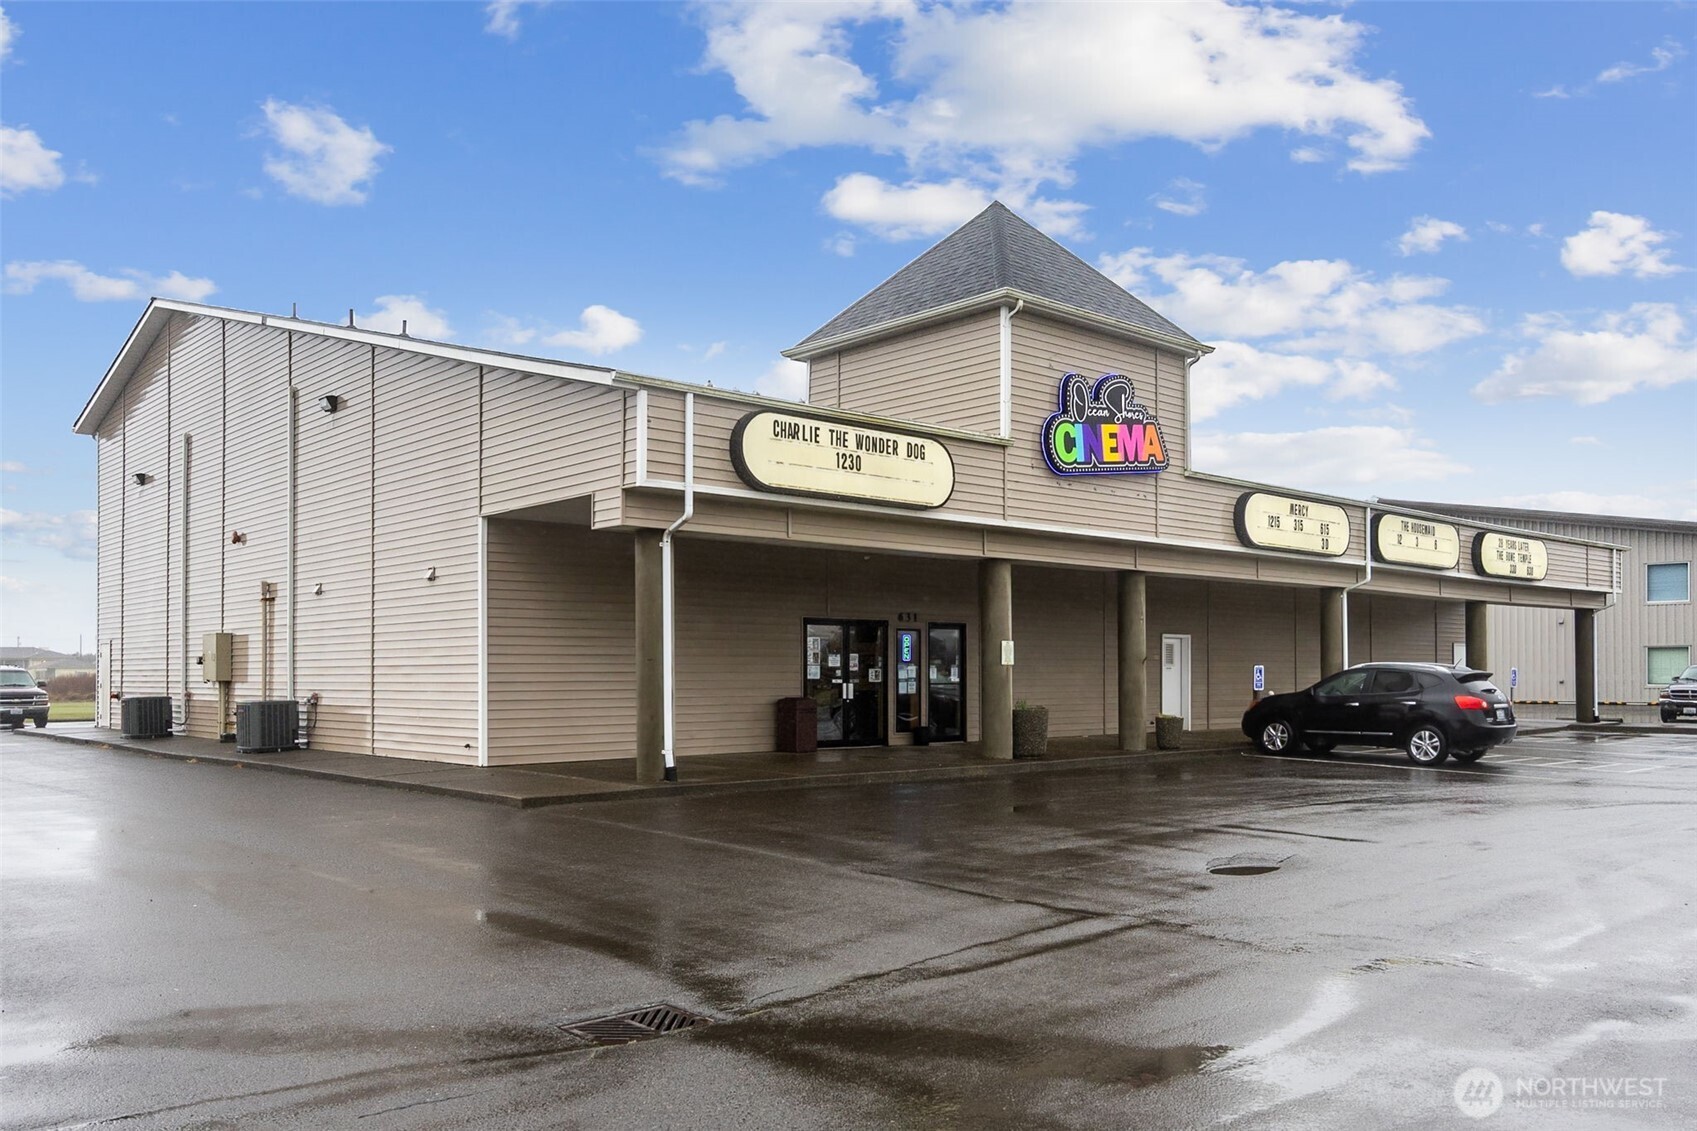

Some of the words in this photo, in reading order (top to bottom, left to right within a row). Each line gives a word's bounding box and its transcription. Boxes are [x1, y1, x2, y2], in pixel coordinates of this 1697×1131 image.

[1073, 382, 1110, 422] Ocean
[1104, 383, 1144, 424] Shores
[773, 419, 821, 444] CHARLIE
[828, 428, 849, 448] THE
[855, 433, 899, 456] WONDER
[906, 441, 926, 461] DOG
[1054, 422, 1165, 463] CINEMA
[835, 452, 862, 472] 1230
[1289, 503, 1309, 517] MERCY
[1267, 515, 1281, 528] 1215
[1293, 518, 1304, 532] 315
[1320, 522, 1330, 536] 615
[1401, 520, 1409, 532] THE
[1411, 522, 1436, 537] HOUSEMAID
[897, 612, 918, 622] 631
